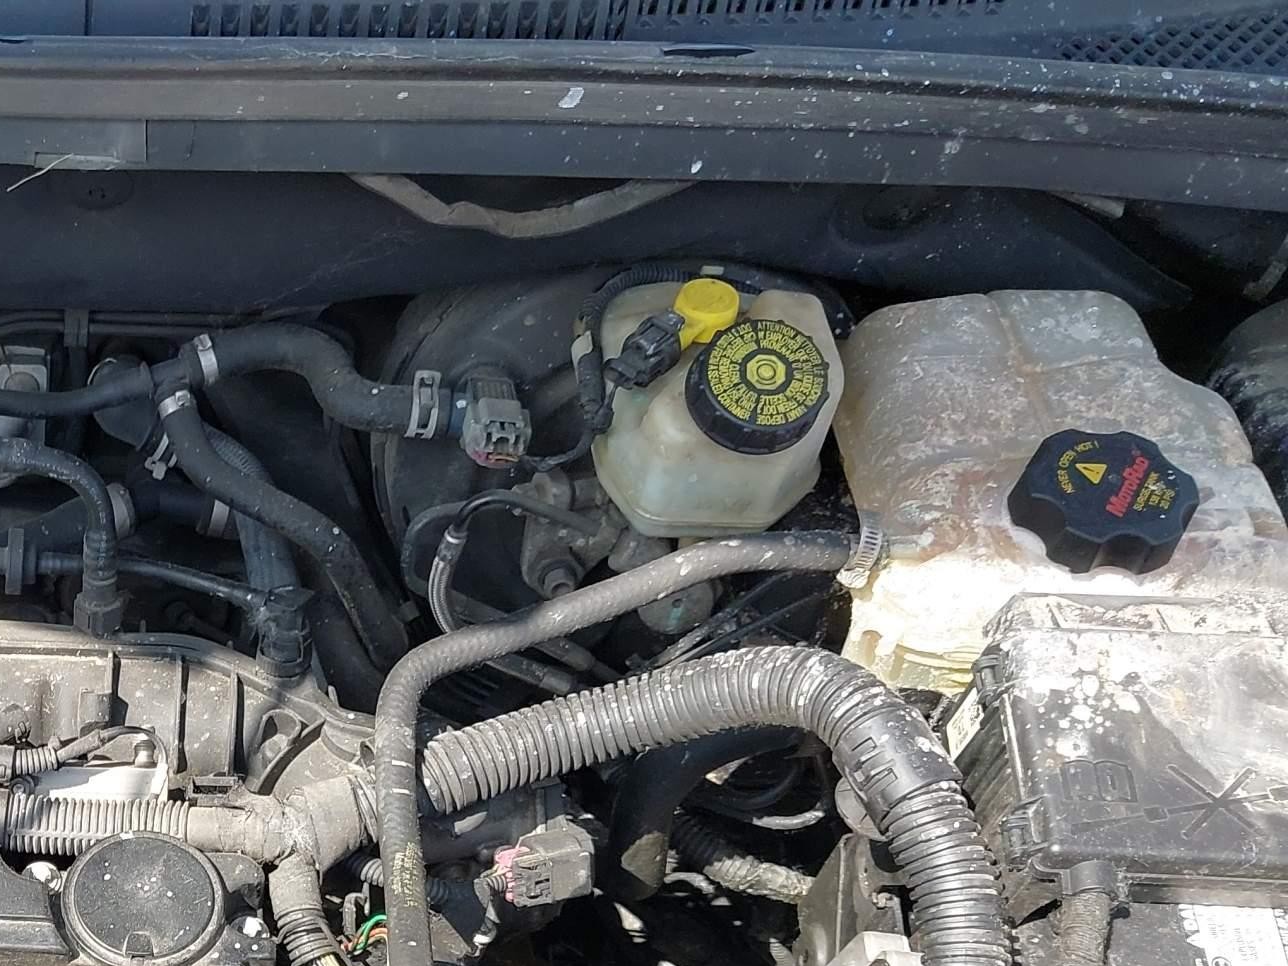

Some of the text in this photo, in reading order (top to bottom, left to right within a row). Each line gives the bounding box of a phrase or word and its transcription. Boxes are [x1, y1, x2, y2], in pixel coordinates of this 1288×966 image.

[736, 322, 753, 336] DOT
[756, 321, 797, 337] ATTENTION
[794, 331, 823, 364] NETTOYER
[813, 366, 824, 375] LE
[762, 404, 776, 415] DOT
